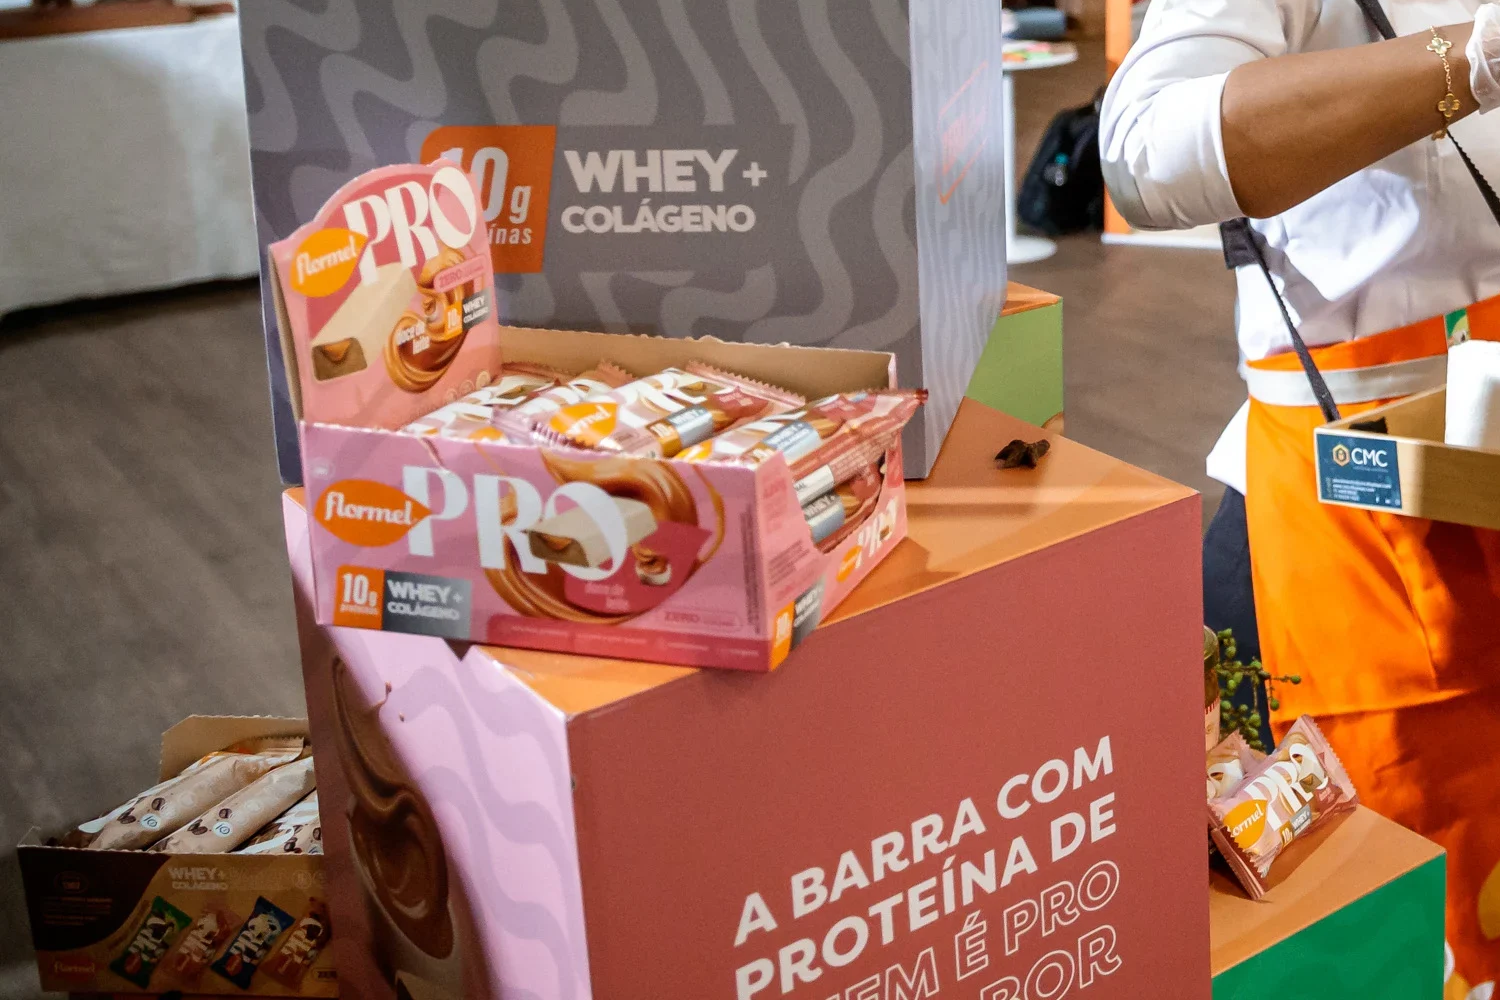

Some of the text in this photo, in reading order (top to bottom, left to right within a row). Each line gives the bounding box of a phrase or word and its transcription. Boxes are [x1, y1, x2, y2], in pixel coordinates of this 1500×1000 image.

[343, 166, 477, 286] PRO
[561, 199, 756, 233] COLÁGENO
[296, 236, 358, 285] flormel
[1351, 447, 1388, 467] CMC
[325, 490, 412, 525] flormel
[402, 466, 628, 581] PRO
[343, 573, 377, 607] 10g
[1227, 802, 1264, 838] ormel
[1244, 743, 1329, 831] PRO
[734, 735, 1114, 947] A BARRA COM
[736, 836, 1038, 1000] PROTEÍNA
[1050, 792, 1117, 863] DE
[955, 911, 990, 981] É
[1003, 860, 1121, 956] PRO
